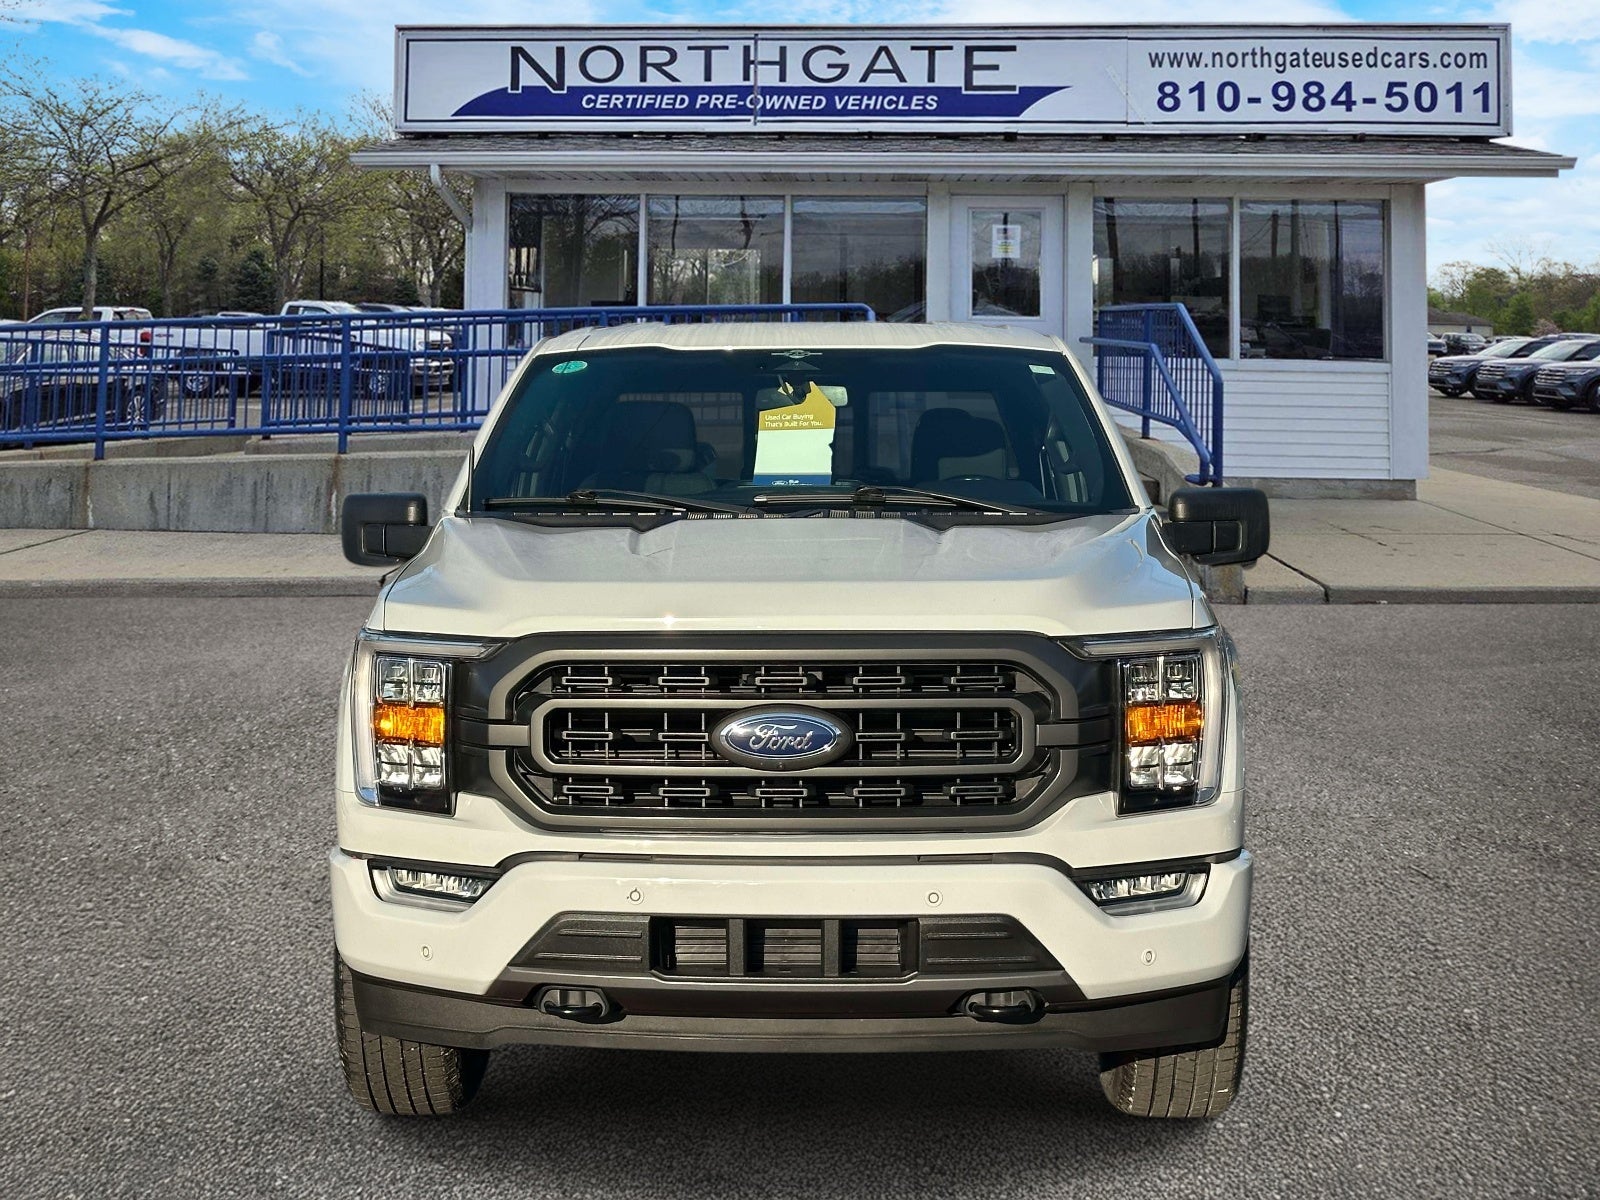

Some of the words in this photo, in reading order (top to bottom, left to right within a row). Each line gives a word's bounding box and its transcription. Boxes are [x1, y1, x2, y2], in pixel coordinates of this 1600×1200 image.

[509, 44, 1018, 93] NORTHGATE
[1148, 45, 1488, 74] www.northgateusedcars.com
[581, 94, 690, 109] CERTIFIED
[695, 94, 827, 110] PRE-OWNED
[834, 95, 939, 111] VEHICLES
[1156, 80, 1491, 114] 810-984-5011
[792, 413, 814, 421] Buying
[749, 723, 814, 751] Ford
